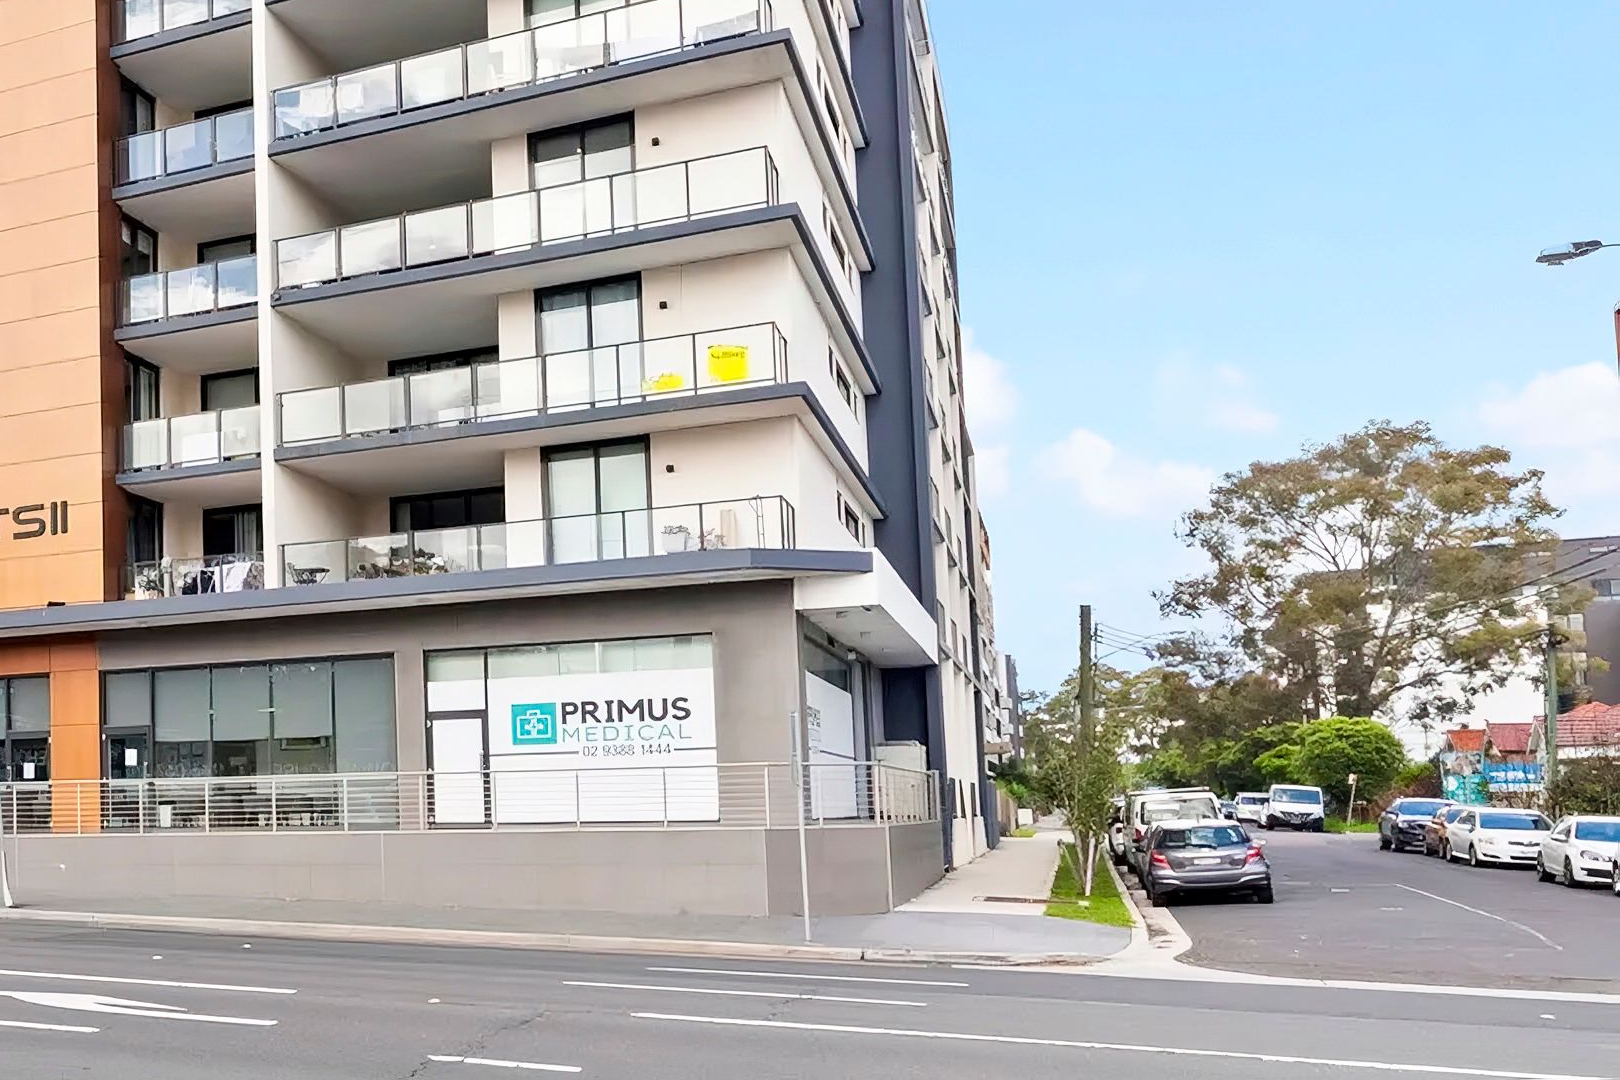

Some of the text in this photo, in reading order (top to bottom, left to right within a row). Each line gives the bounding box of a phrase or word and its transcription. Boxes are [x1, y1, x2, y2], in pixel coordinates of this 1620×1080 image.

[561, 696, 692, 725] PRIMUS
[562, 723, 693, 743] MEDICAL
[582, 745, 598, 757] 02
